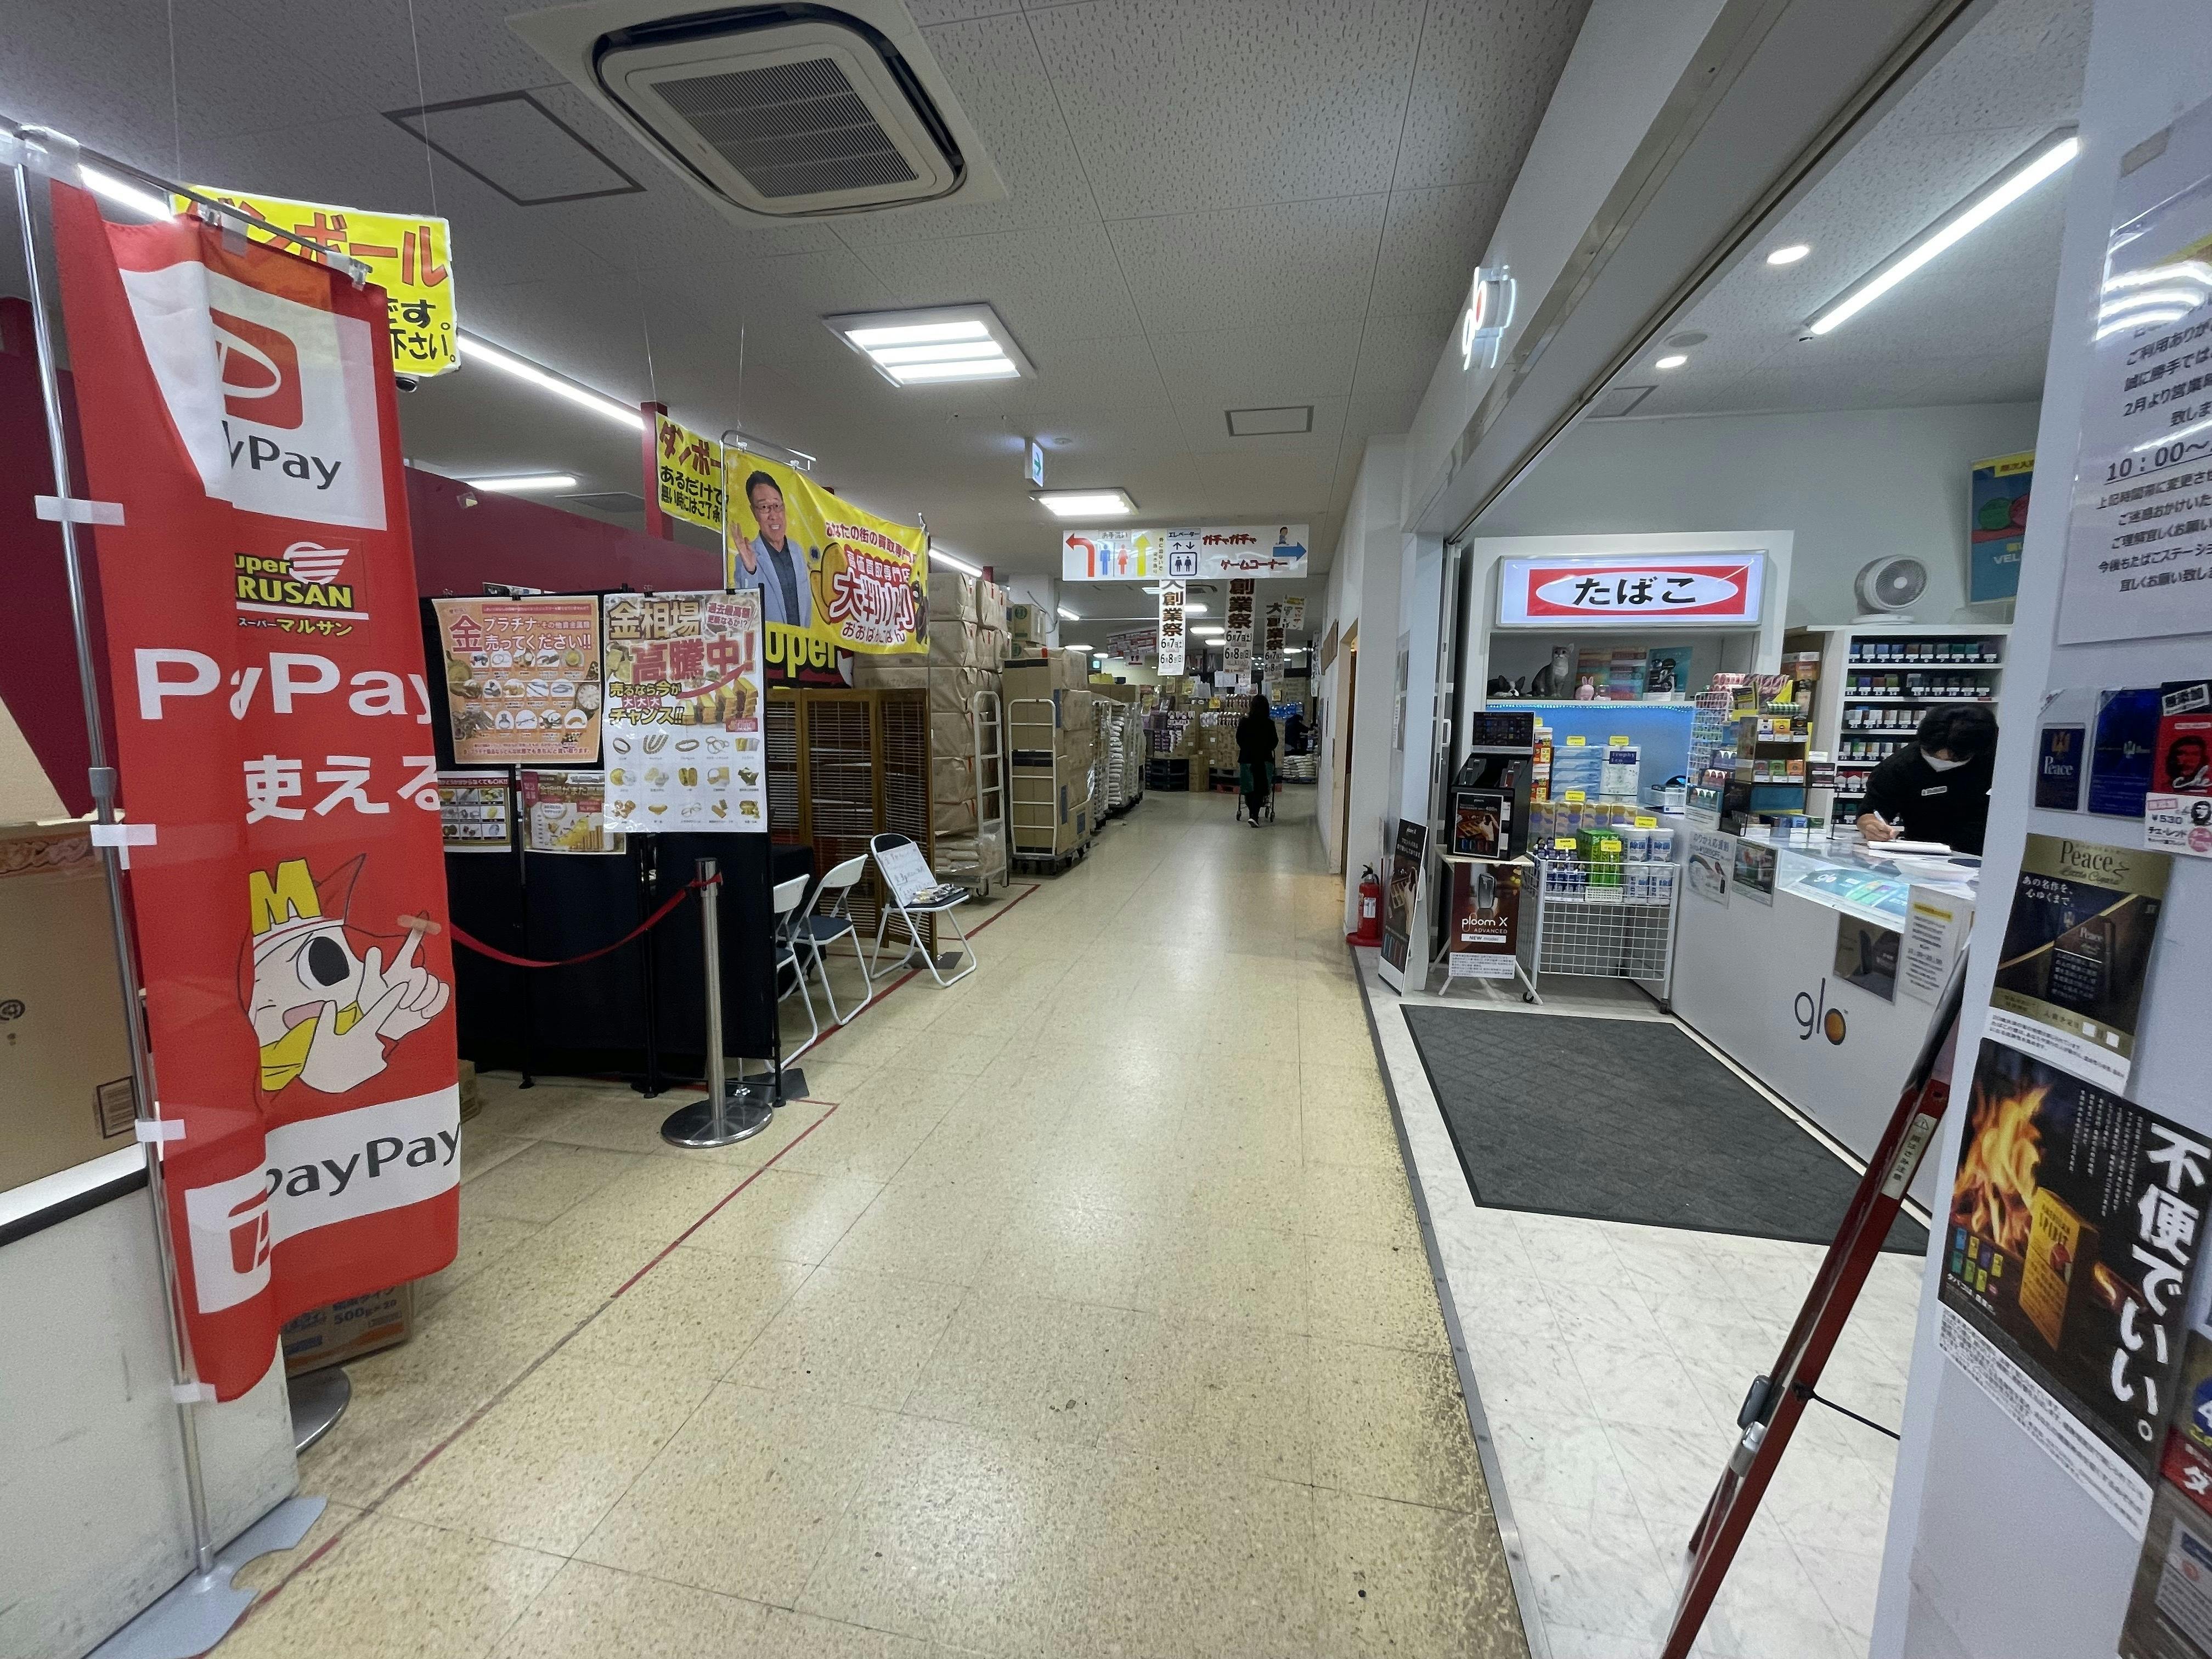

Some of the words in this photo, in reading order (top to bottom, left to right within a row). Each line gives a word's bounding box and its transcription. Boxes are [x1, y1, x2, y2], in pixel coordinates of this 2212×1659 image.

[1571, 577, 1696, 605] たばこ
[448, 614, 483, 652] 金
[608, 601, 701, 640] 金相場
[2044, 756, 2074, 776] Peace
[2059, 840, 2113, 872] Peace
[1462, 912, 1496, 932] ploom
[1499, 917, 1508, 927] X
[1795, 978, 1846, 1045] glo
